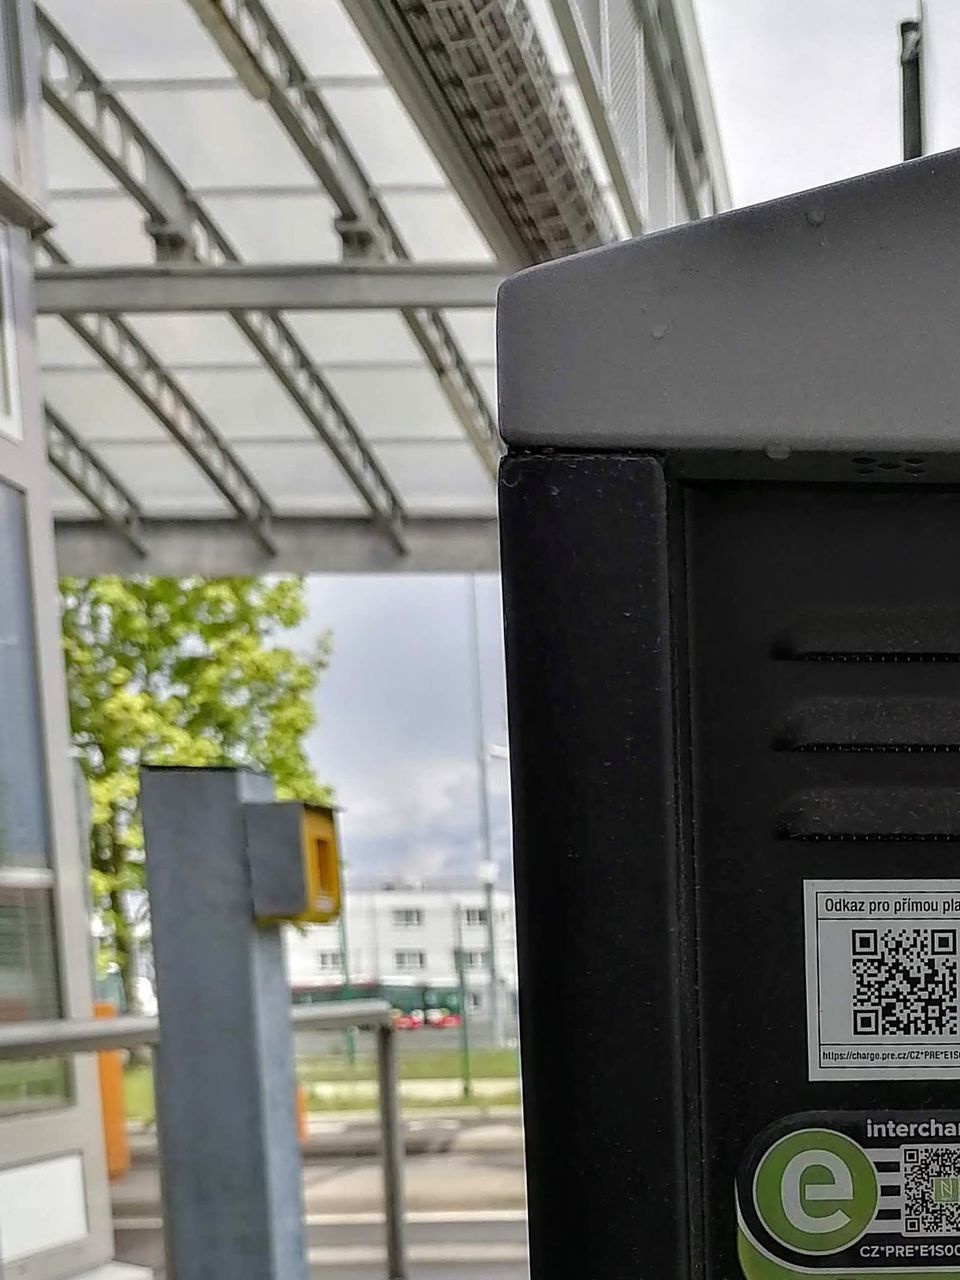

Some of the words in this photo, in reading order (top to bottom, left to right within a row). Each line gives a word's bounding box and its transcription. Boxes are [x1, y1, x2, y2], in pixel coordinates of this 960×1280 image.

[825, 898, 865, 912] Odkaz
[869, 900, 890, 915] pro
[894, 897, 939, 915] přímou
